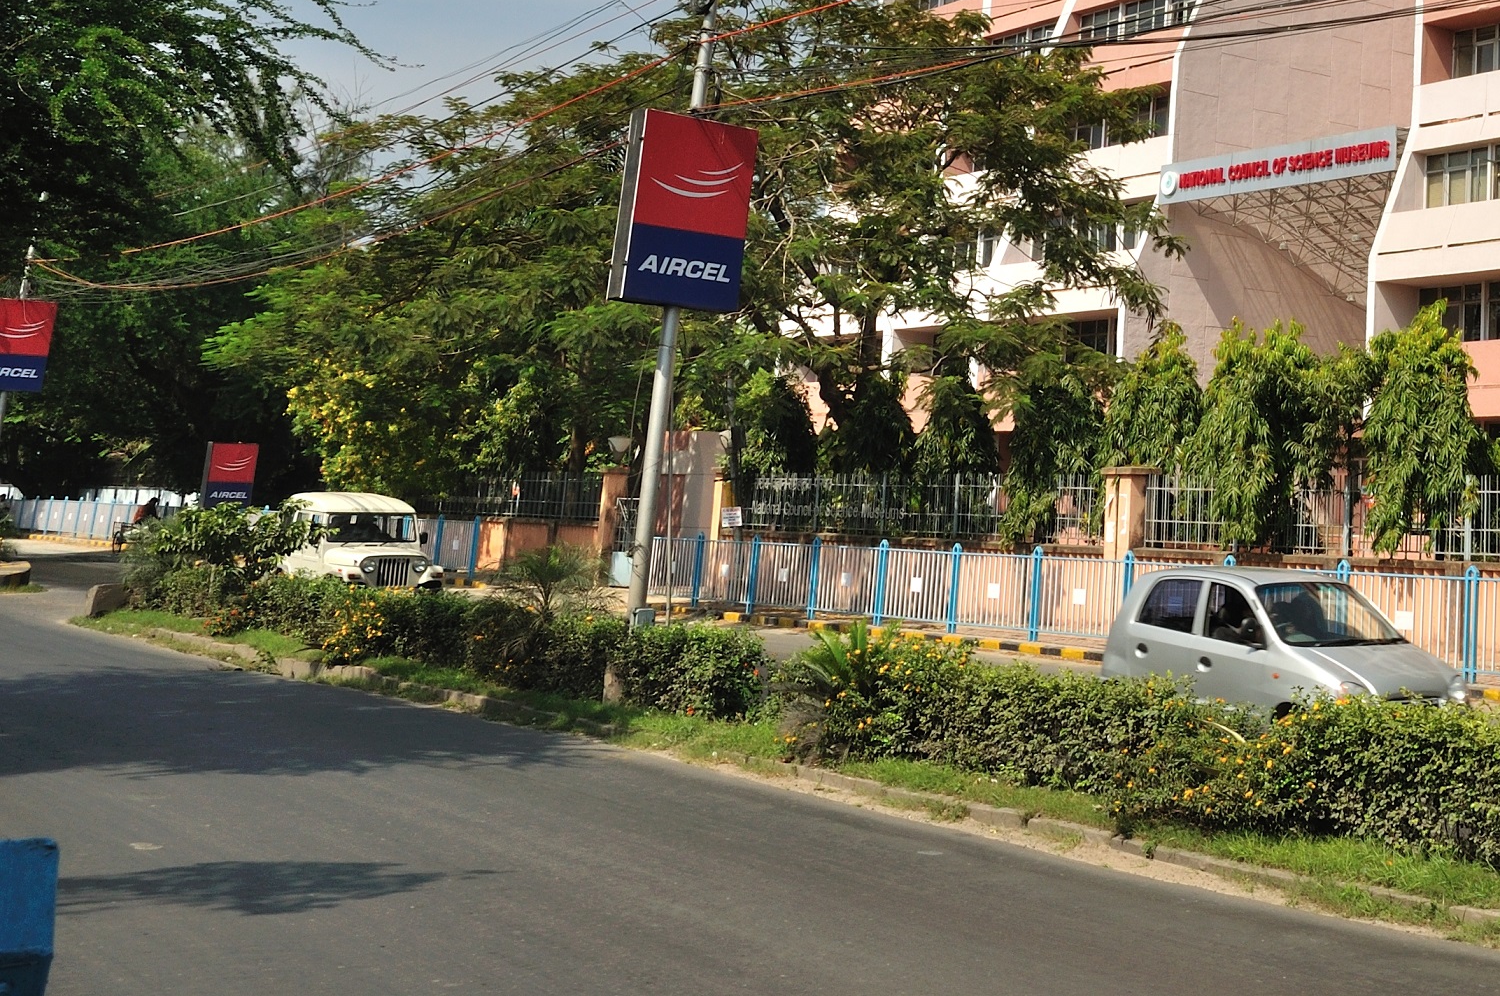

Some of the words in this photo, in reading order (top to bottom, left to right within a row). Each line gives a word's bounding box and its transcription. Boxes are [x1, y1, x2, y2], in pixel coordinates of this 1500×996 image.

[1179, 167, 1225, 189] NATIONAL
[1228, 160, 1271, 181] COUNCIL
[1272, 157, 1287, 174] OF
[1288, 149, 1333, 172] SCIENCE
[1335, 140, 1390, 164] MUSEUMS
[638, 254, 731, 283] AIRCEL
[0, 366, 38, 378] RCEL
[751, 500, 781, 515] National
[783, 501, 812, 516] Council
[861, 503, 905, 520] Museums
